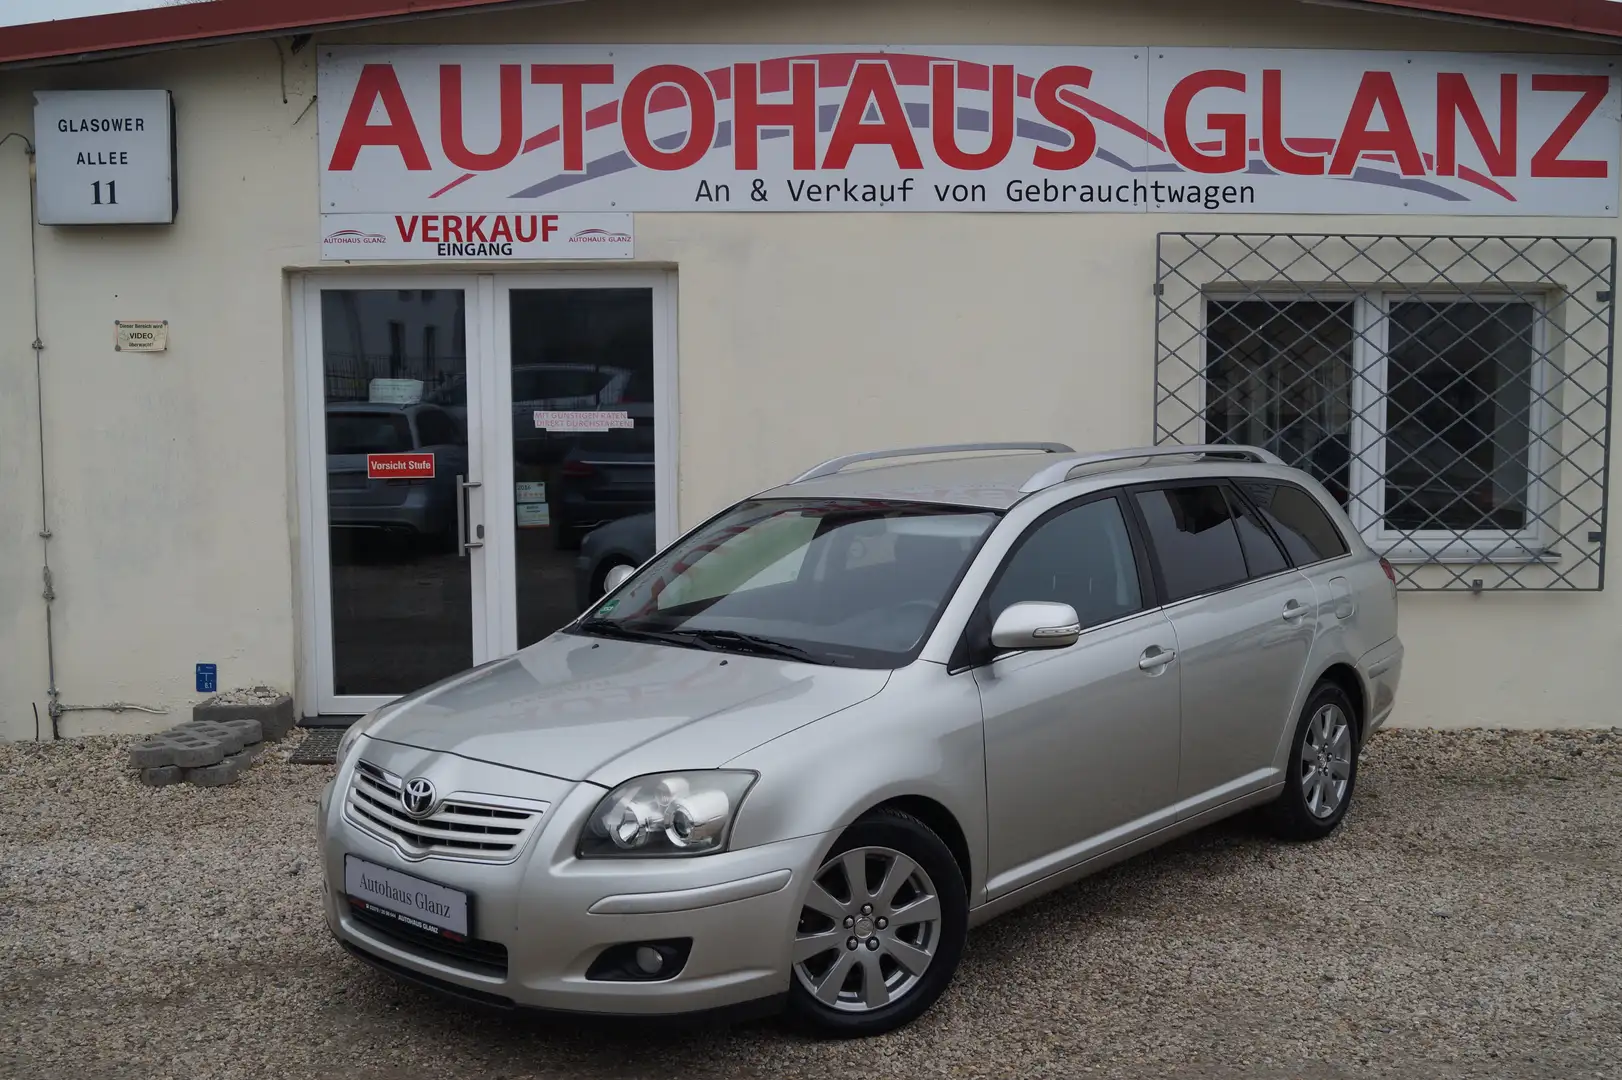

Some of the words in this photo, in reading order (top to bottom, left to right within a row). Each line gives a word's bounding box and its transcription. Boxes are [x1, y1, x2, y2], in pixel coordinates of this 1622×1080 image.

[58, 118, 144, 132] GLASOWER
[328, 62, 1096, 171] AUTOHAUS
[1163, 69, 1610, 178] GLANZ
[77, 151, 128, 165] ALLEE
[91, 180, 118, 204] 11
[696, 179, 730, 202] An
[751, 179, 768, 202] &
[787, 177, 914, 202] Verkauf
[935, 184, 986, 202] von
[1006, 178, 1254, 210] Gebrauchtwagen
[395, 215, 559, 243] VERKAUF
[437, 243, 513, 256] EINGANG
[371, 461, 406, 470] Vorsicht
[408, 460, 431, 470] Stufe
[360, 873, 412, 906] Autohaus
[415, 892, 451, 919] Glanz
